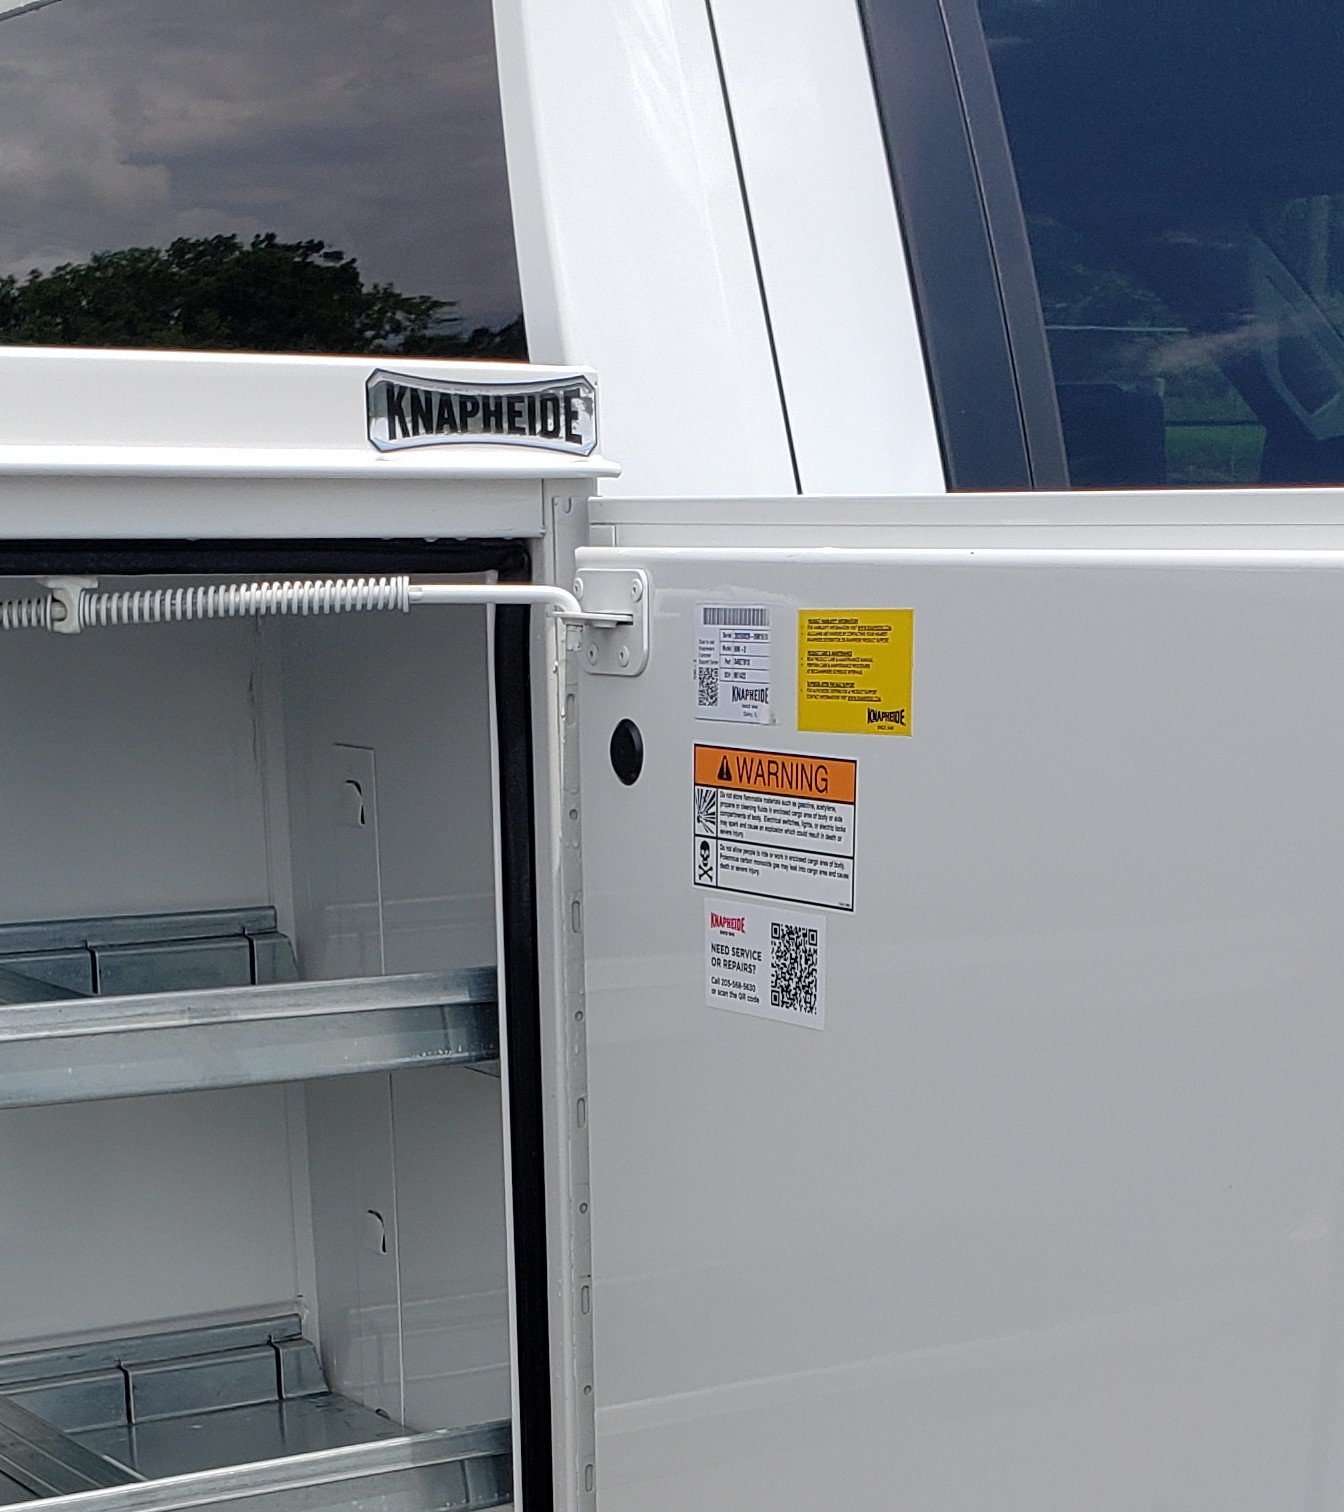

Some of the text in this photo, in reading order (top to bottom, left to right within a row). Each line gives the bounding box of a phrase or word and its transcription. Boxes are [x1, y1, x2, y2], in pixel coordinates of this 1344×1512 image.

[386, 381, 583, 444] KNAPHEIDE
[732, 686, 768, 704] KNAPHEIDE
[868, 708, 906, 726] KNAPHEIDE
[737, 757, 829, 794] WARNING
[711, 912, 745, 933] KNAPHEIDE
[711, 943, 762, 961] NEED SERVICE
[711, 957, 756, 974] OR REPAIRS?
[711, 976, 720, 984] Call
[747, 995, 760, 1003] code
